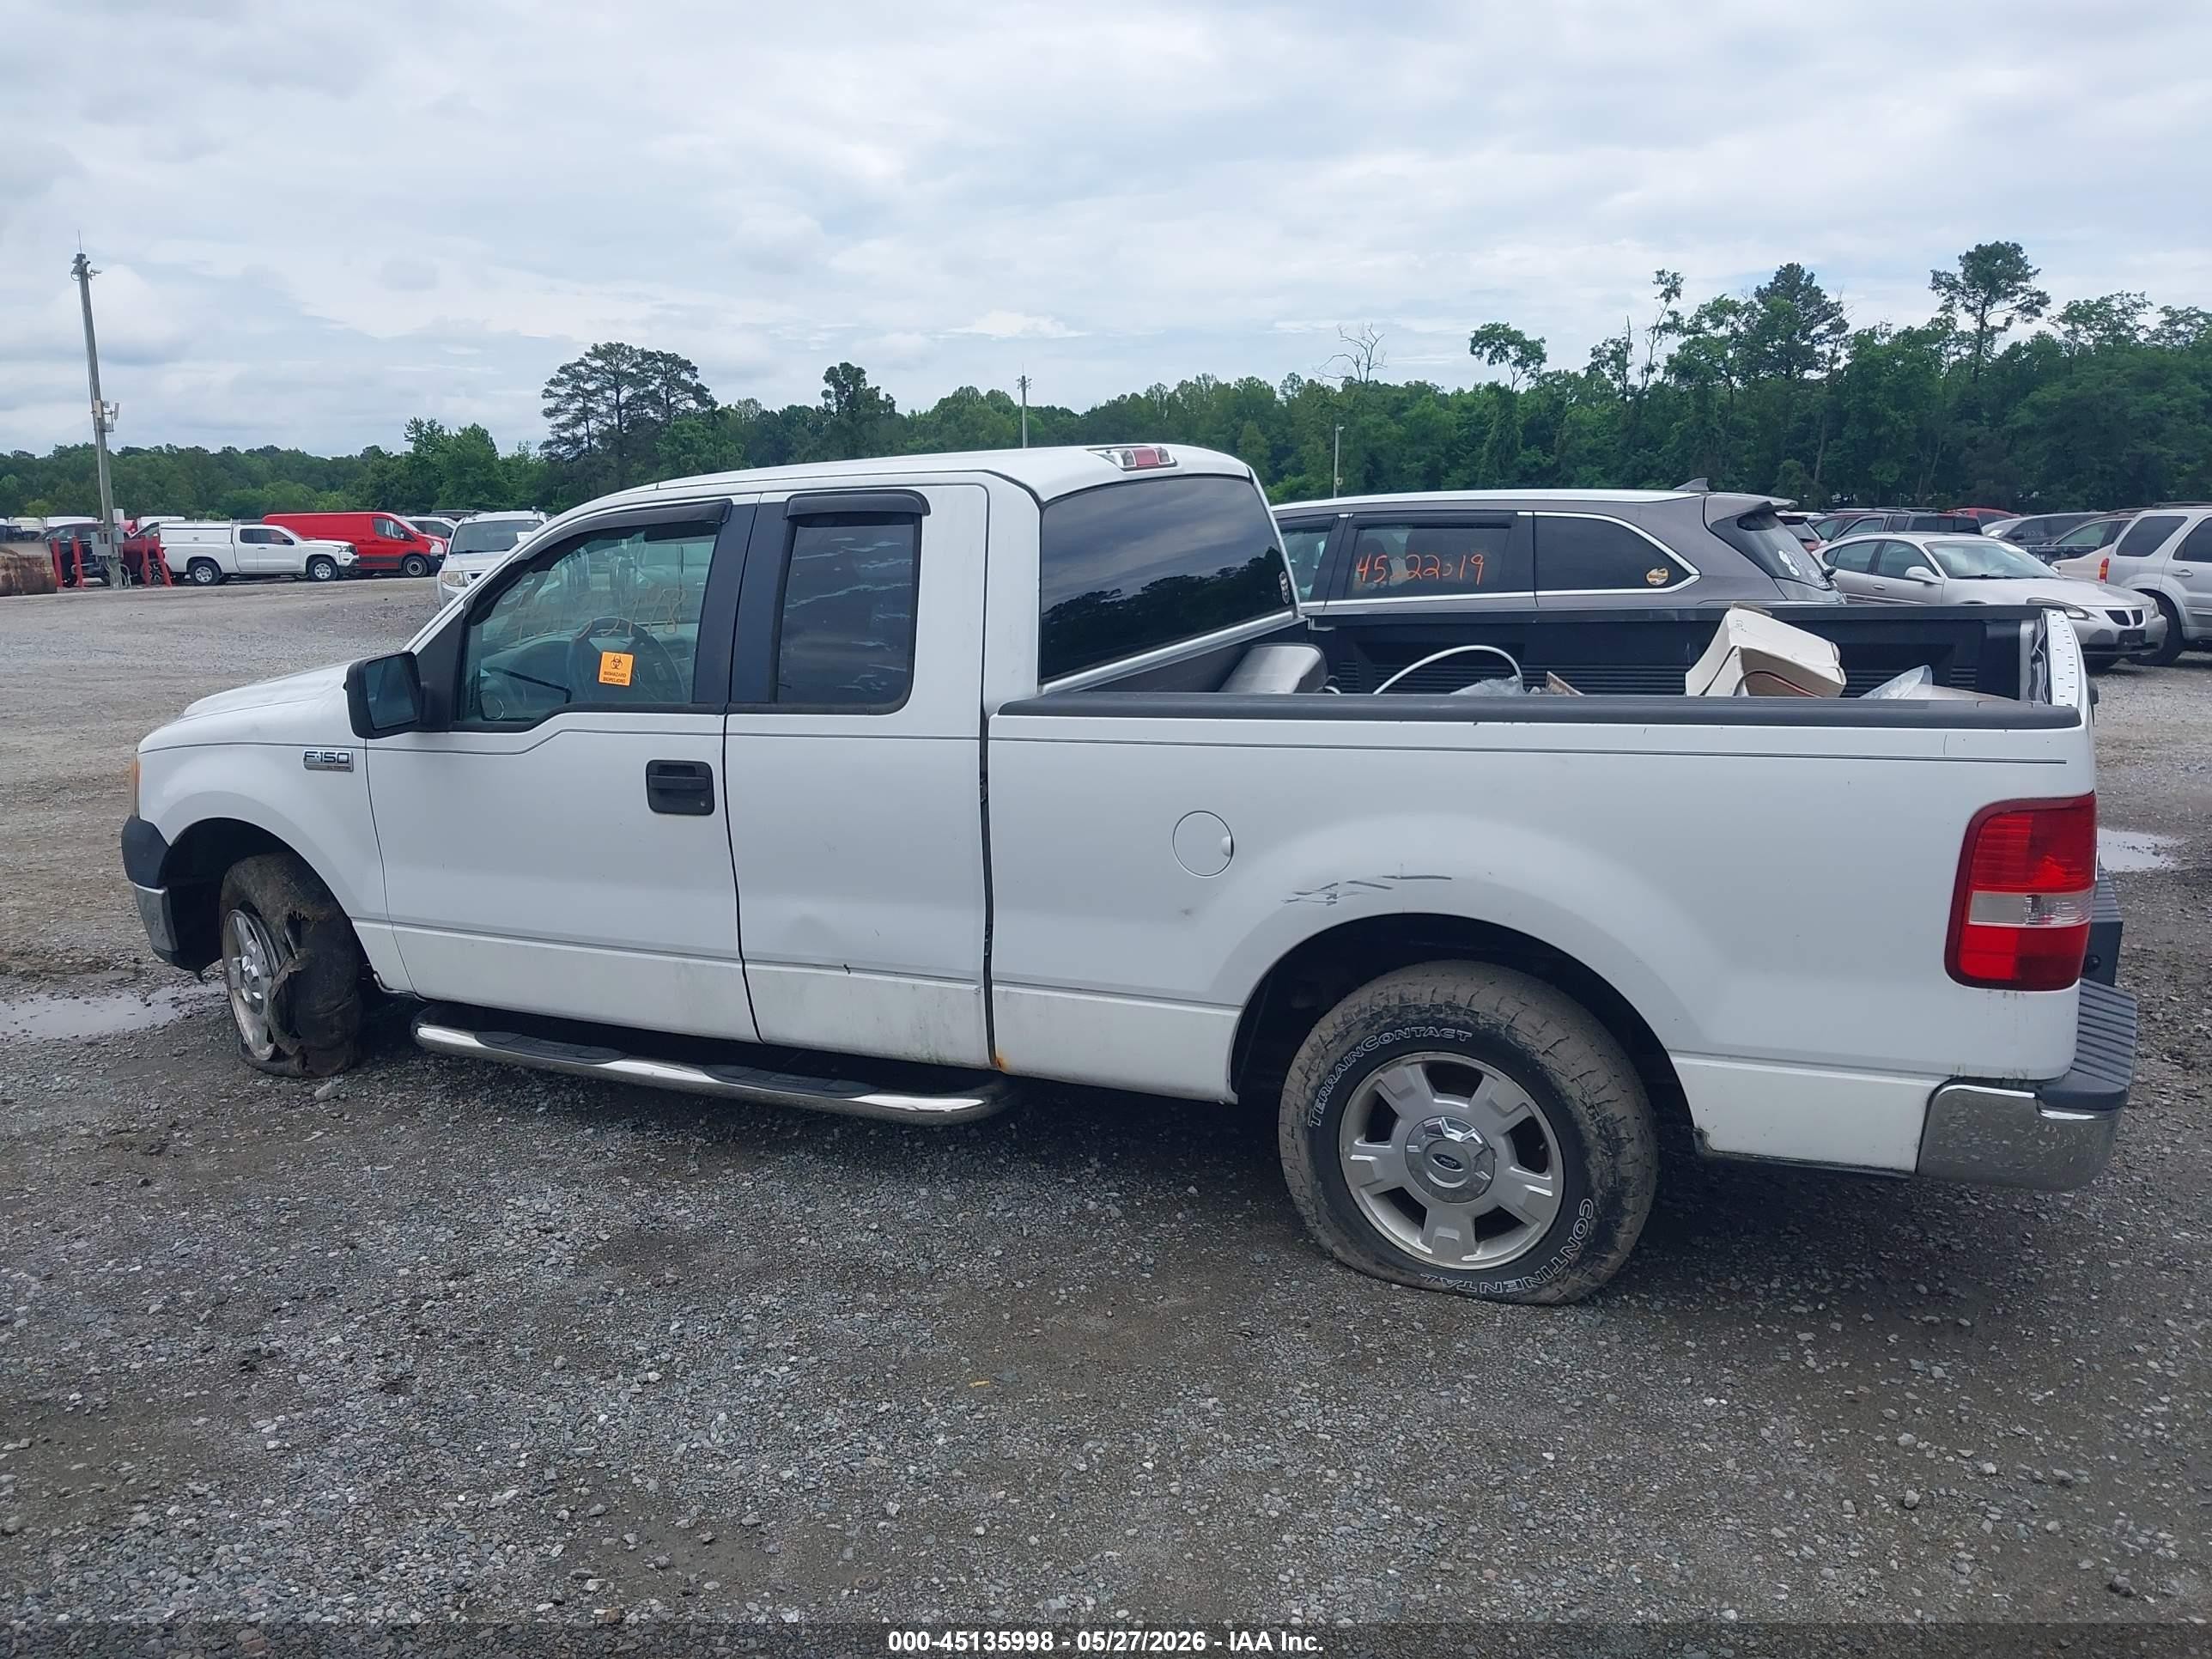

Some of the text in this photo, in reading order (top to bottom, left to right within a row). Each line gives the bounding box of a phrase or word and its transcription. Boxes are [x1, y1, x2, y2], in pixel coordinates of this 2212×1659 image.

[1357, 553, 1484, 586] 452219
[304, 751, 349, 763] F-150
[1419, 1198, 1594, 1294] CONTINENTAL
